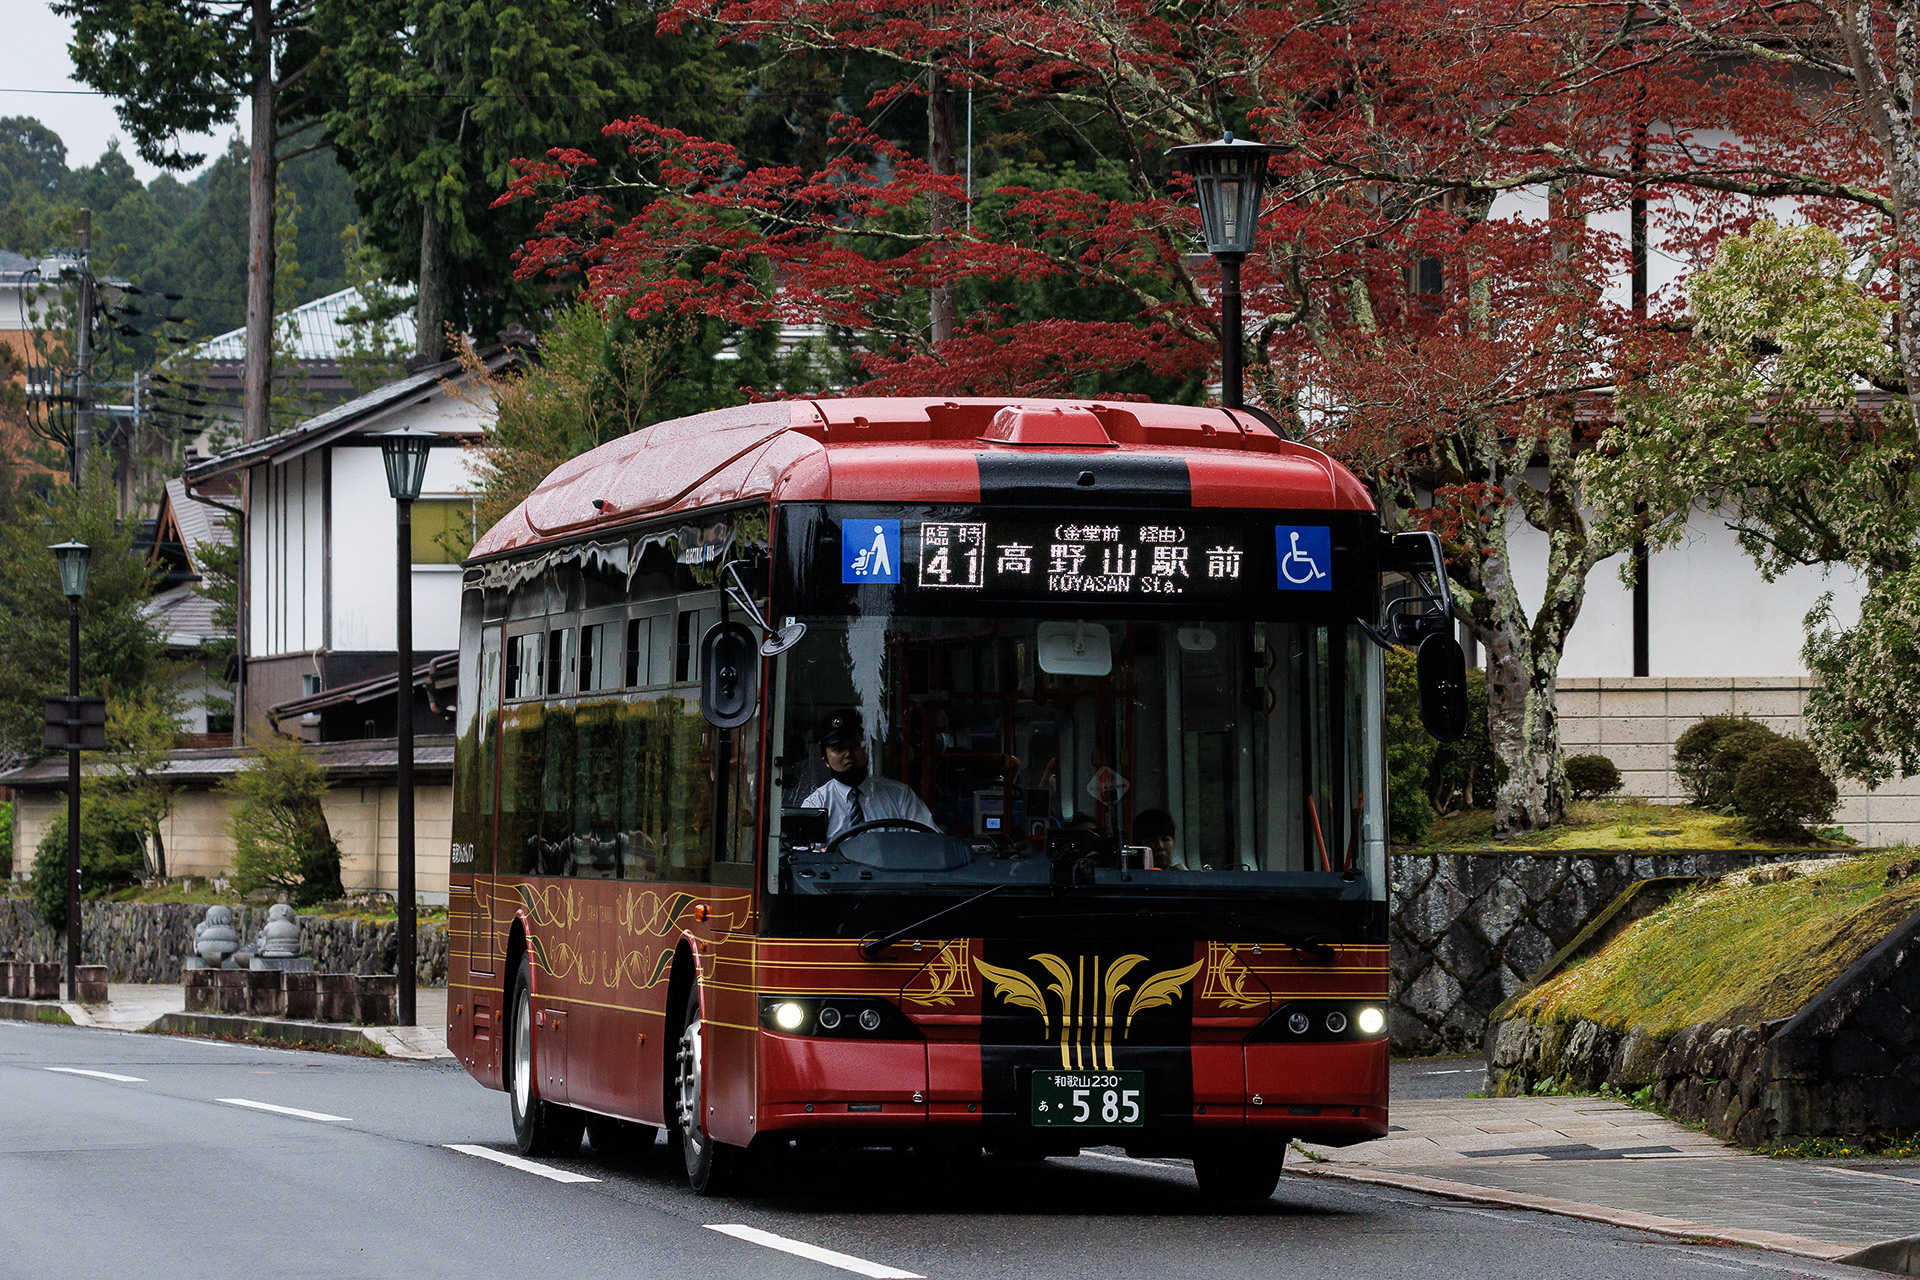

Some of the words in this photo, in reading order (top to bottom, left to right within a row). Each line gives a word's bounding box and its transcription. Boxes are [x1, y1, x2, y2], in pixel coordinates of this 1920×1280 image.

[926, 526, 982, 546] 臨時
[926, 546, 977, 583] 41
[996, 542, 1244, 578] 高野山駅前
[1048, 574, 1131, 593] KOYASAN
[1140, 576, 1183, 593] Sta.
[1038, 1100, 1049, 1112] あ
